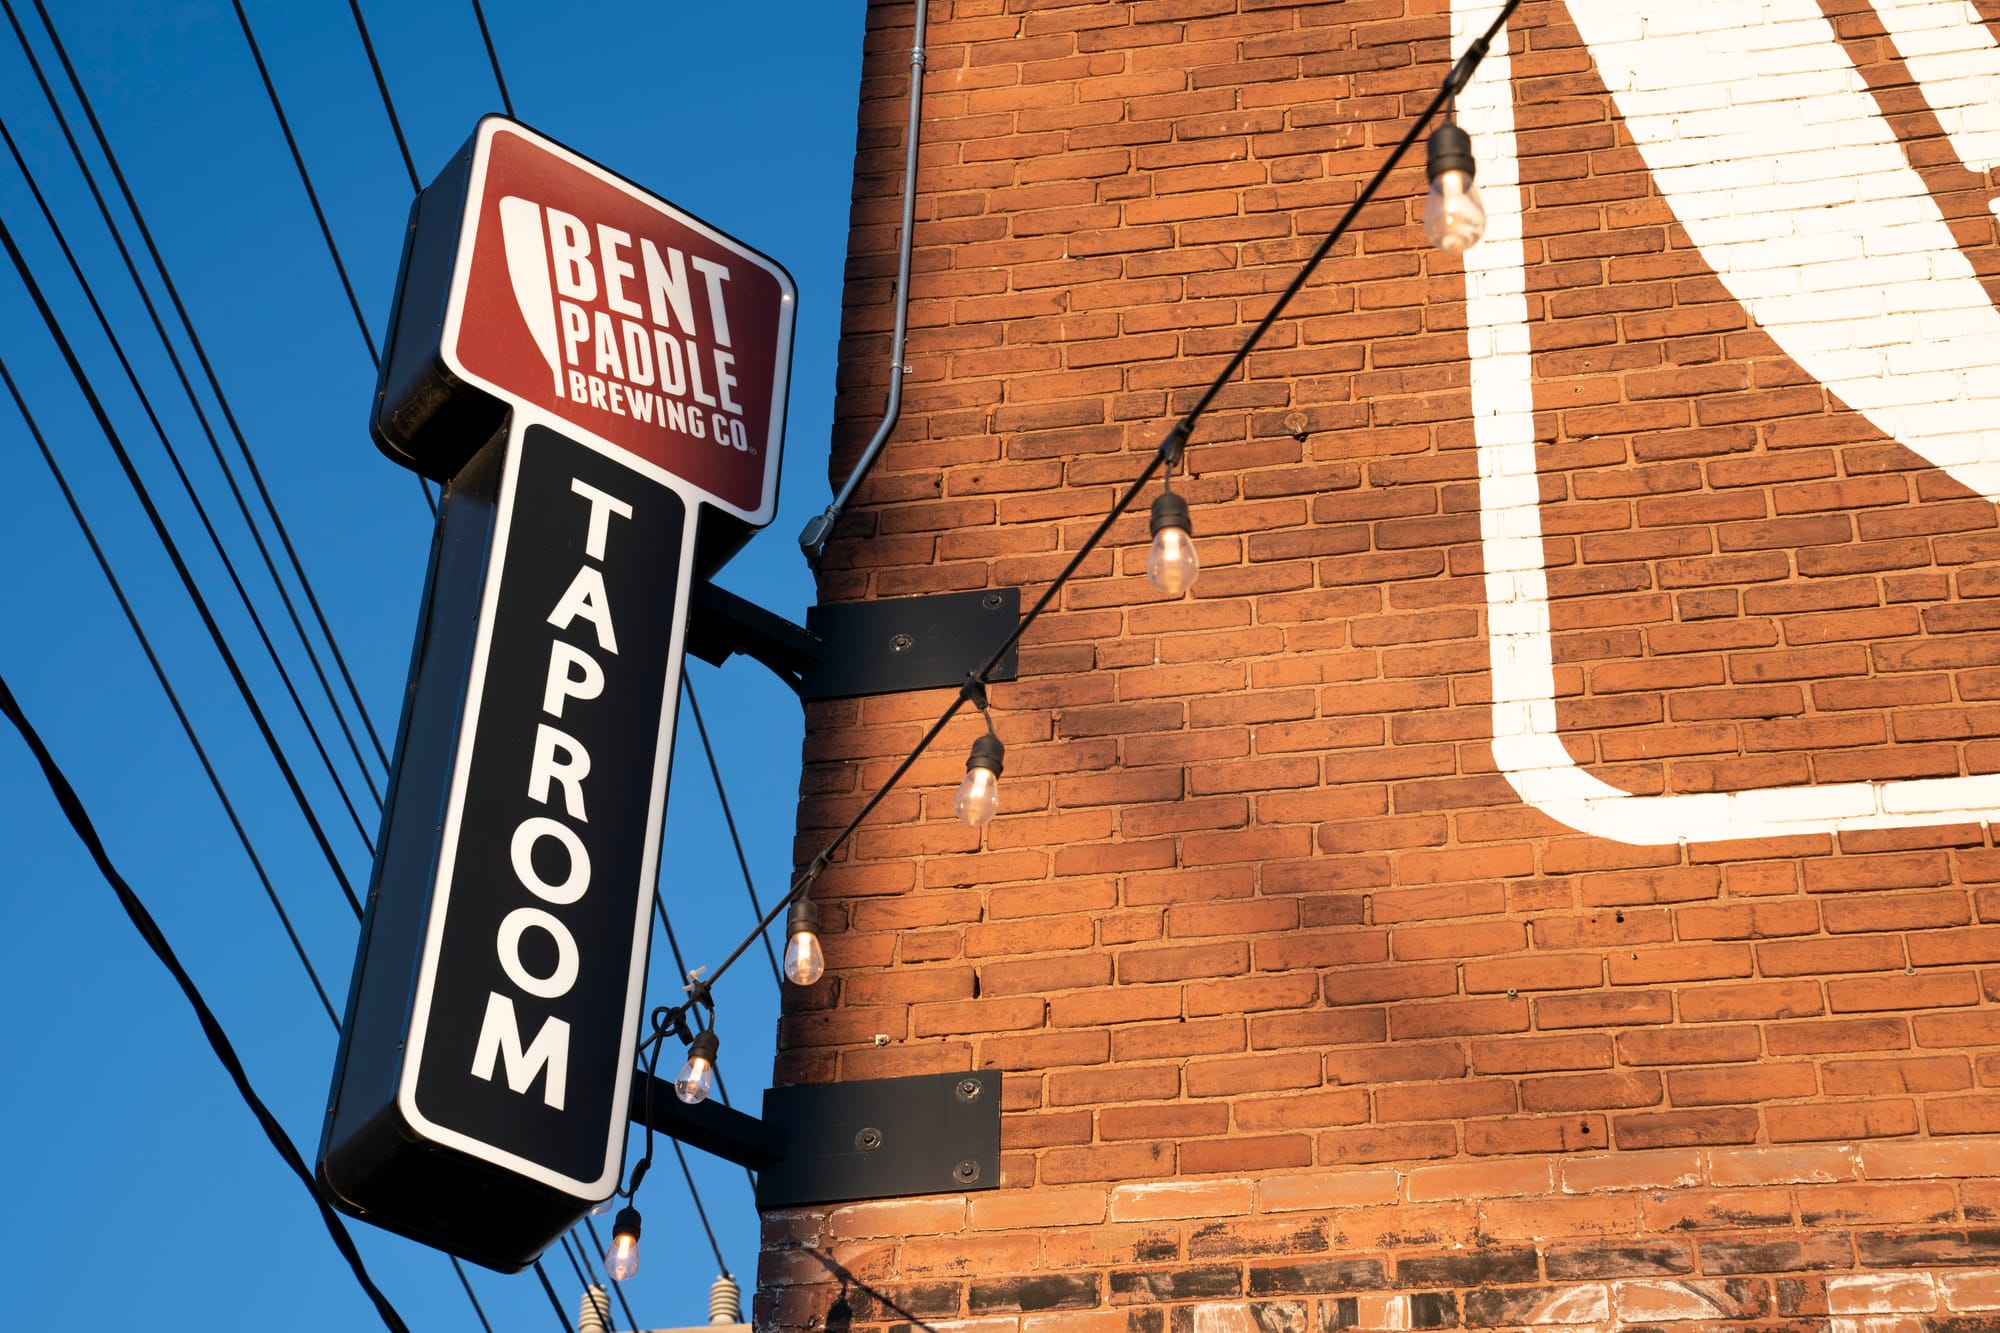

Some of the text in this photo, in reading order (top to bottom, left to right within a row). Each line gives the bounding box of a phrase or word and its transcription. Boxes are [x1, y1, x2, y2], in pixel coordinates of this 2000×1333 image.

[546, 206, 731, 348] BENT
[559, 300, 743, 416] PADDLE
[568, 369, 706, 439] BREWING
[471, 478, 633, 1112] TAPROOM
